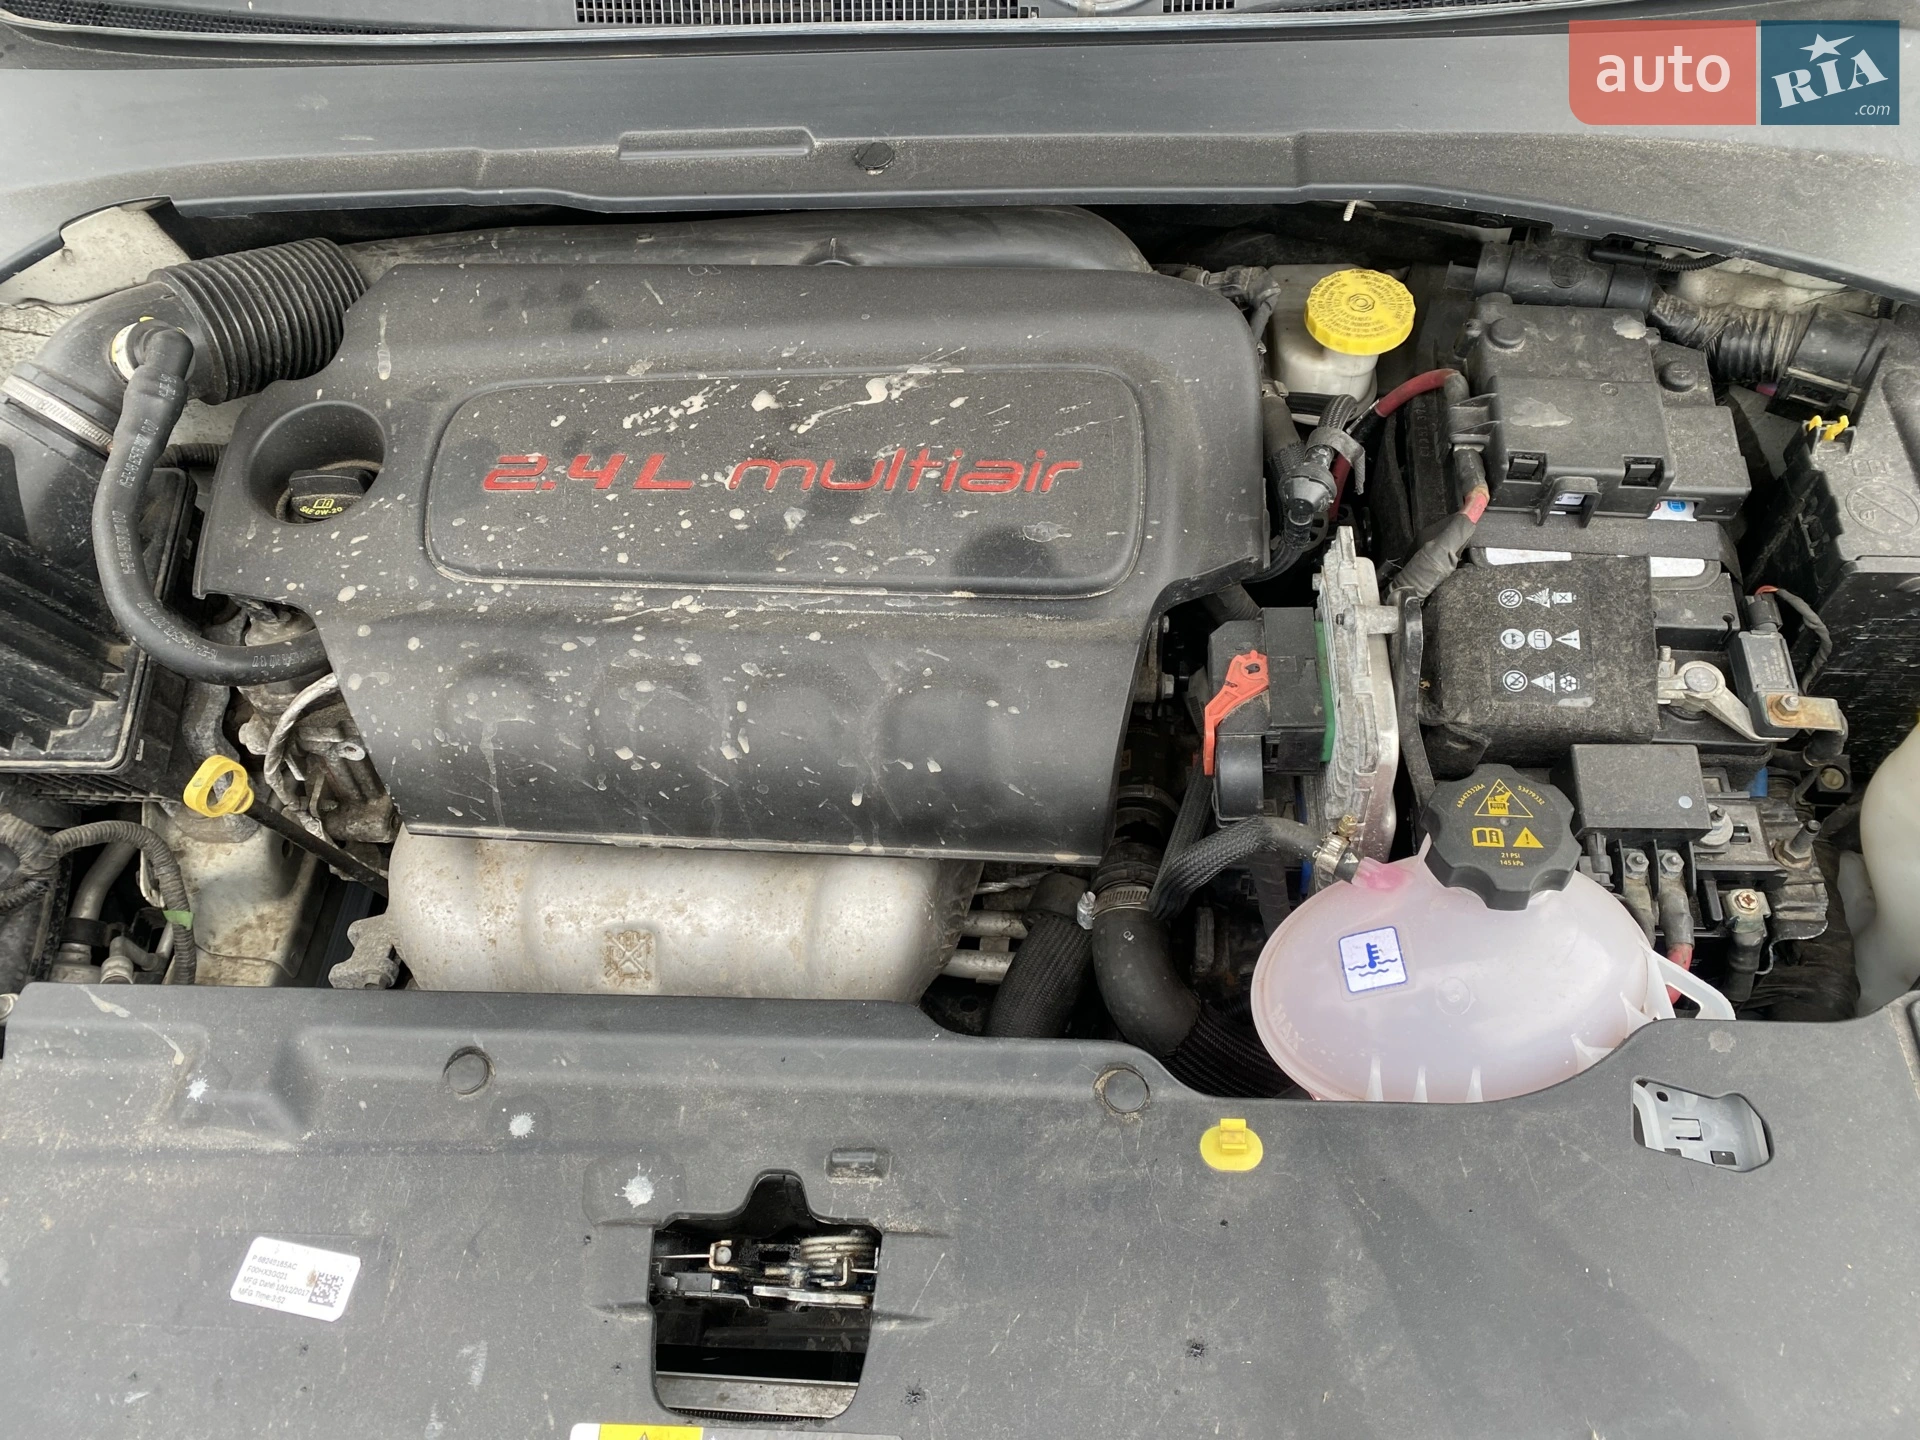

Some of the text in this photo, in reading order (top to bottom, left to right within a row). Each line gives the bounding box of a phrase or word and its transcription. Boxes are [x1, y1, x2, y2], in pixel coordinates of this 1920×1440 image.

[726, 447, 1082, 493] multiair
[299, 505, 343, 516] SAE 0W-20
[243, 1276, 258, 1286] MFG
[237, 1287, 253, 1297] MFG
